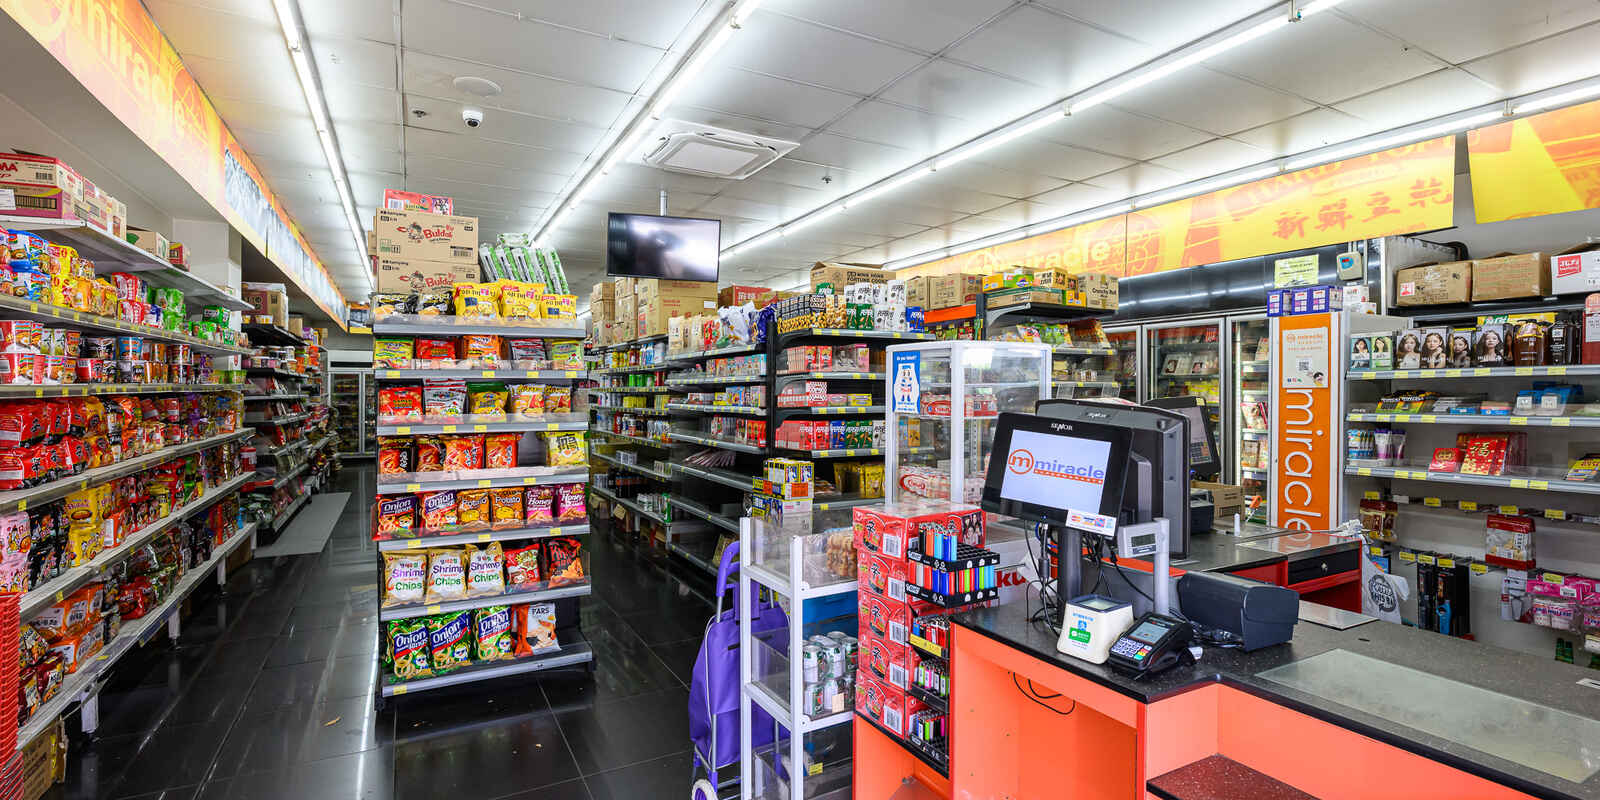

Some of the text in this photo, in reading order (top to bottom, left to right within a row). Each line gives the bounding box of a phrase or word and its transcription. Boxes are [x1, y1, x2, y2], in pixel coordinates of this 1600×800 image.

[1034, 459, 1105, 478] miracle
[384, 499, 411, 511] Onion
[528, 498, 553, 506] Honey
[433, 565, 463, 574] Shrimp
[470, 561, 500, 571] Shrimp
[392, 568, 424, 578] Shrimp
[435, 577, 461, 586] Chips
[474, 574, 499, 583] Chips
[395, 582, 422, 591] Chips
[481, 611, 509, 633] Onion
[433, 620, 460, 643] Onion
[396, 631, 426, 647] Onion
